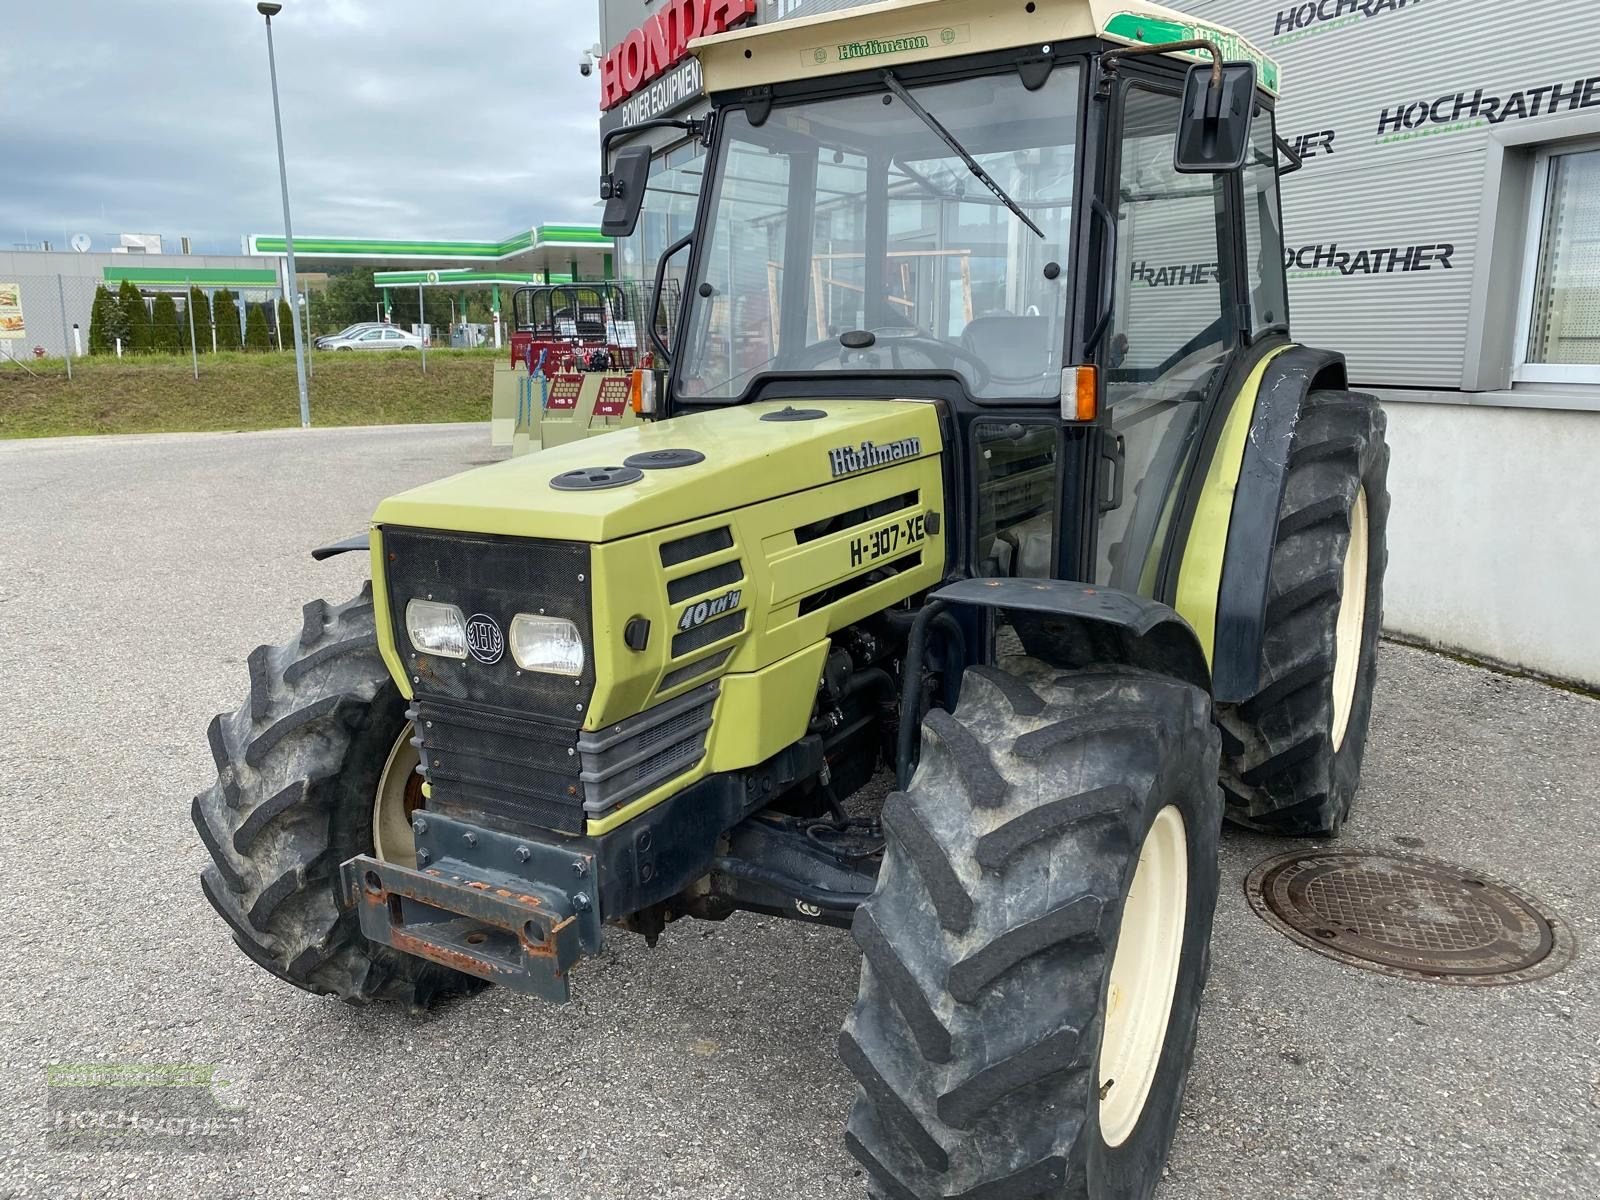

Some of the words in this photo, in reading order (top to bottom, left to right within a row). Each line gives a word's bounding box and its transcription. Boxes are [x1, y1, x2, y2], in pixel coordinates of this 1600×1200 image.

[599, 0, 756, 110] HONDA
[838, 35, 929, 60] Hürlimann
[622, 90, 651, 128] POWER
[831, 438, 920, 475] Hürlimann
[850, 514, 925, 568] H-307-XE
[680, 601, 708, 629] 40
